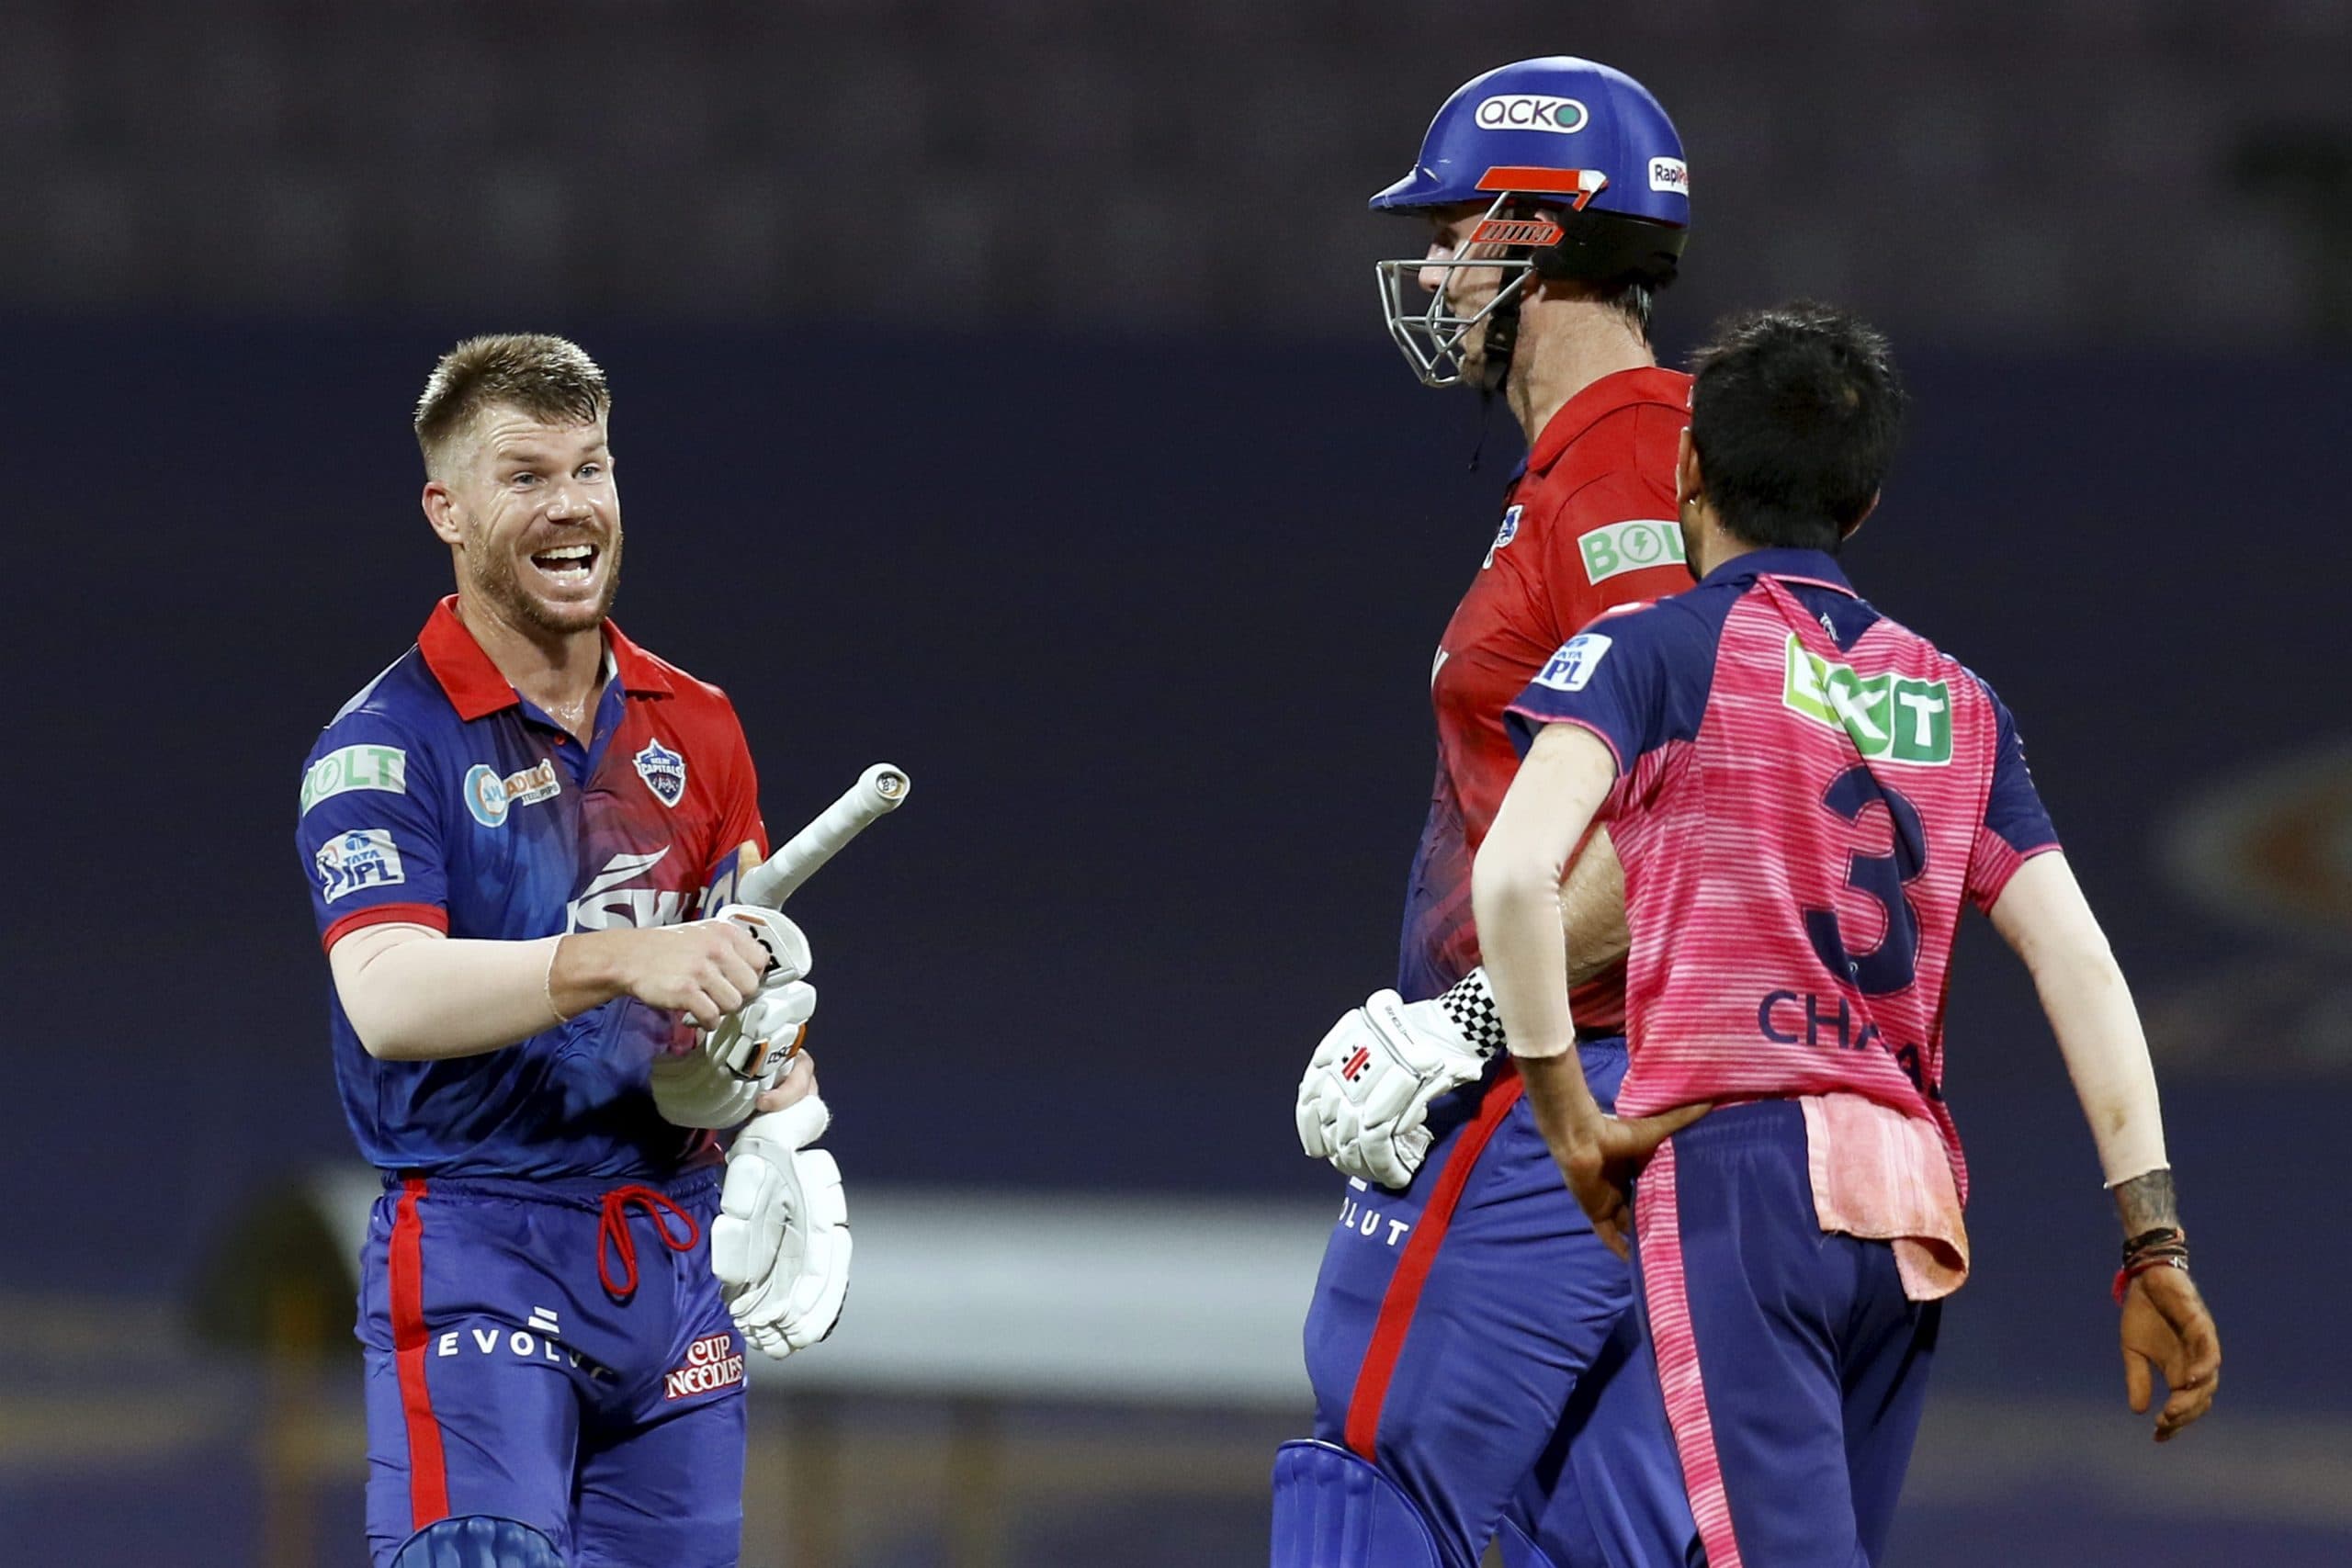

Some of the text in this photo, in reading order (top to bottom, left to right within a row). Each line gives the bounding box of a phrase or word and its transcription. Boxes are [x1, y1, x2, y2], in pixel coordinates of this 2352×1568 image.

[1580, 525, 1687, 579] BOL
[1543, 659, 1582, 684] PL
[640, 763, 682, 777] CAPITALS
[344, 850, 380, 864] TATA
[343, 859, 398, 888] IPL
[1802, 762, 1928, 998] 3
[687, 1336, 730, 1366] CUP
